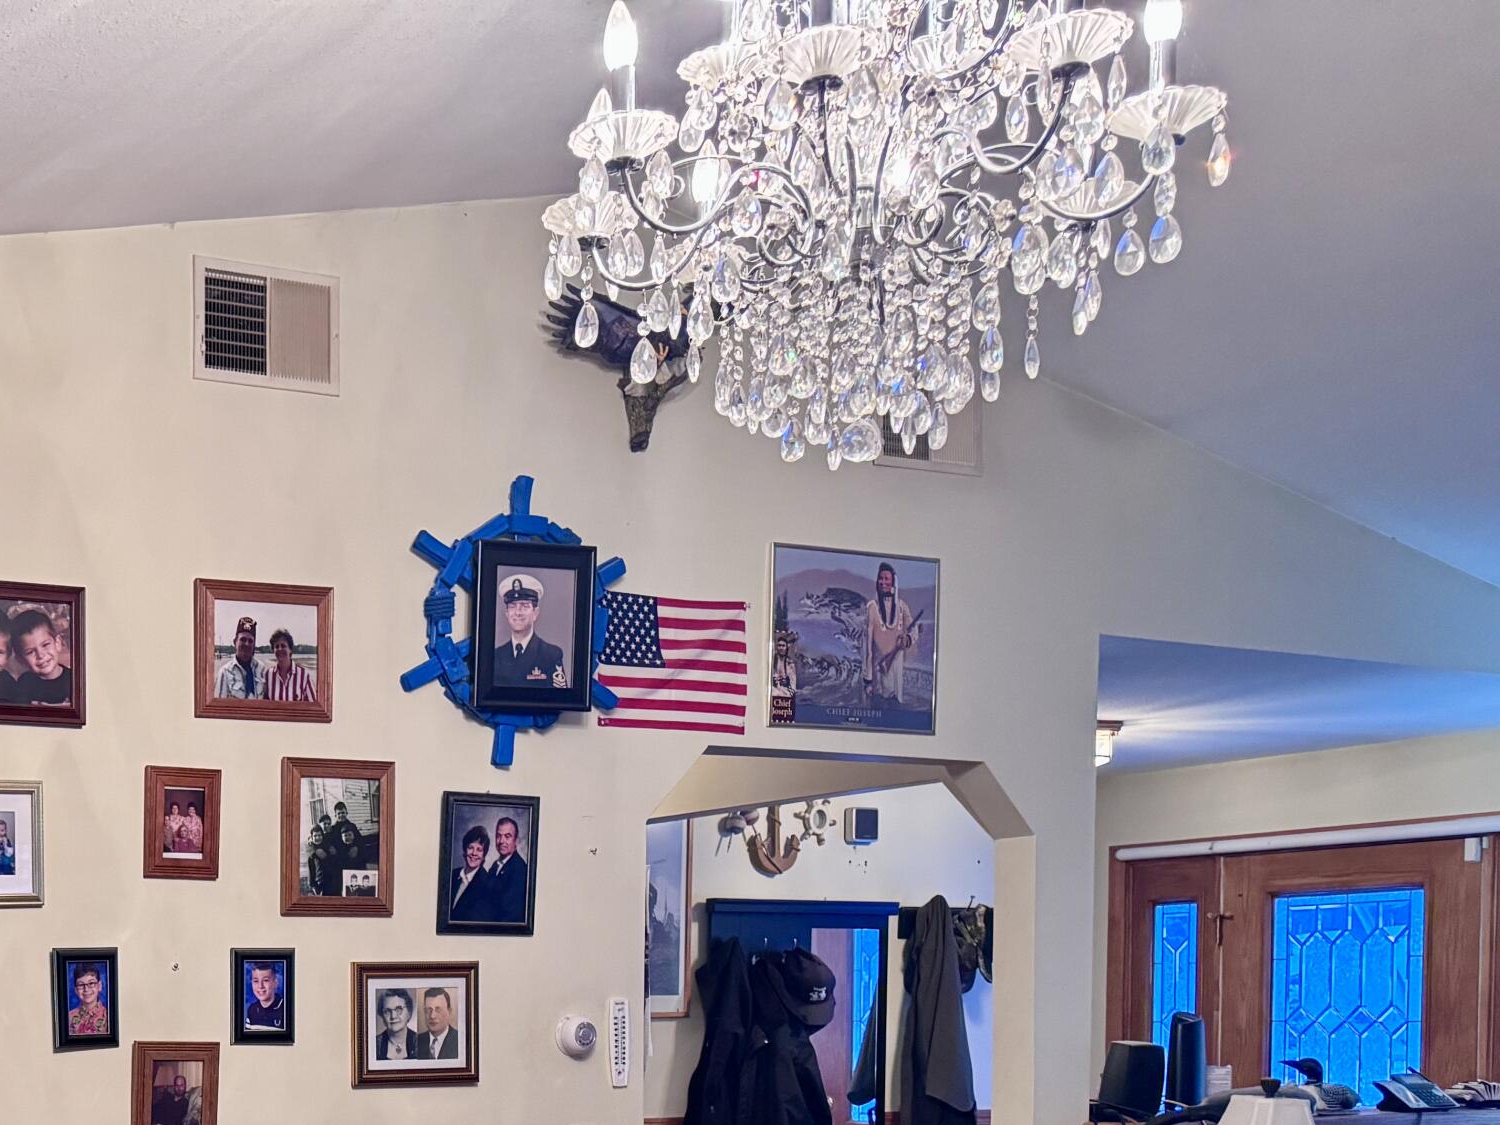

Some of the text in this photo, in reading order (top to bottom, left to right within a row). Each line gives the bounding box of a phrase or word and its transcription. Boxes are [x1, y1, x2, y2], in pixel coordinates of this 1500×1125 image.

[773, 698, 792, 708] Chief
[772, 708, 793, 718] Joseph
[826, 708, 883, 718] CHIEF JOSEPH
